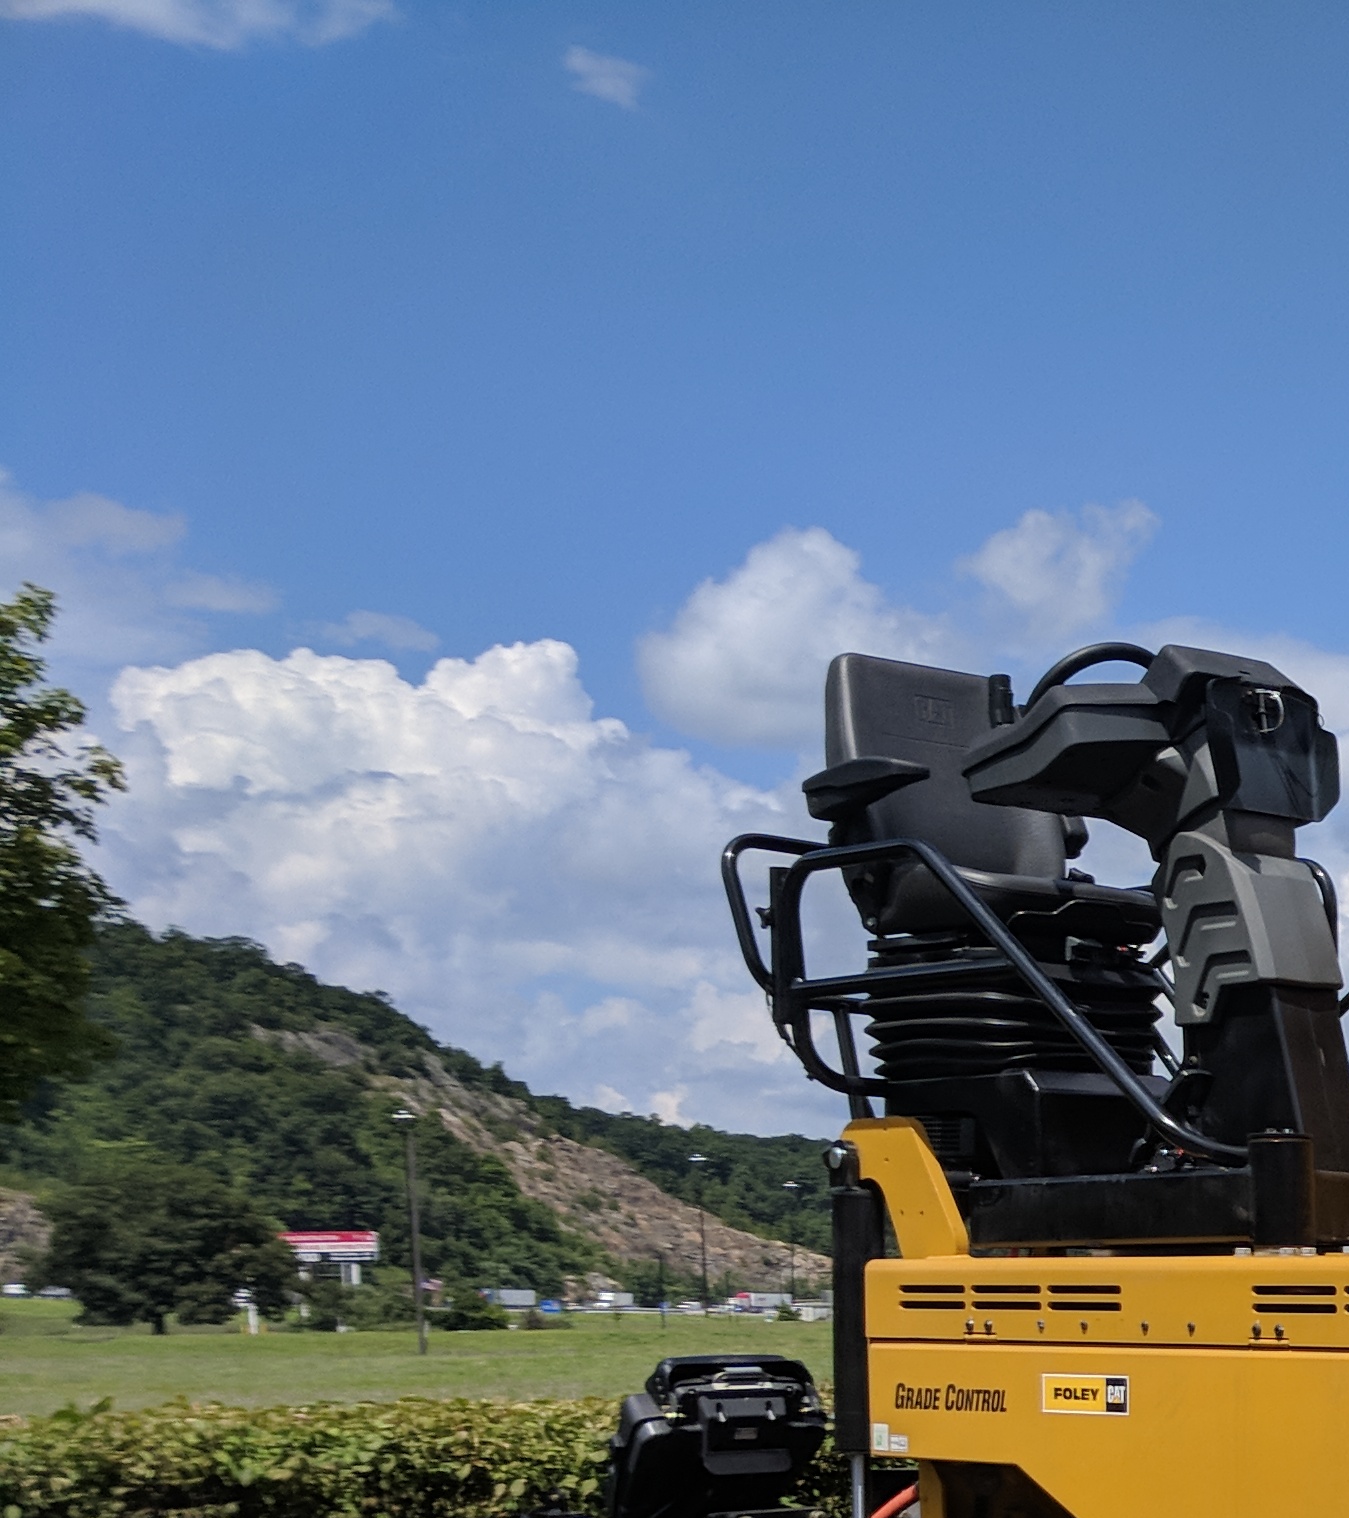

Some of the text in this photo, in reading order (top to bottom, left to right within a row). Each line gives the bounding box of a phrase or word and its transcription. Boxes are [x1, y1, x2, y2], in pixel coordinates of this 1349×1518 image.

[895, 1382, 1008, 1413] GRADE CONTROL
[1053, 1384, 1127, 1404] FOLEY CAT
